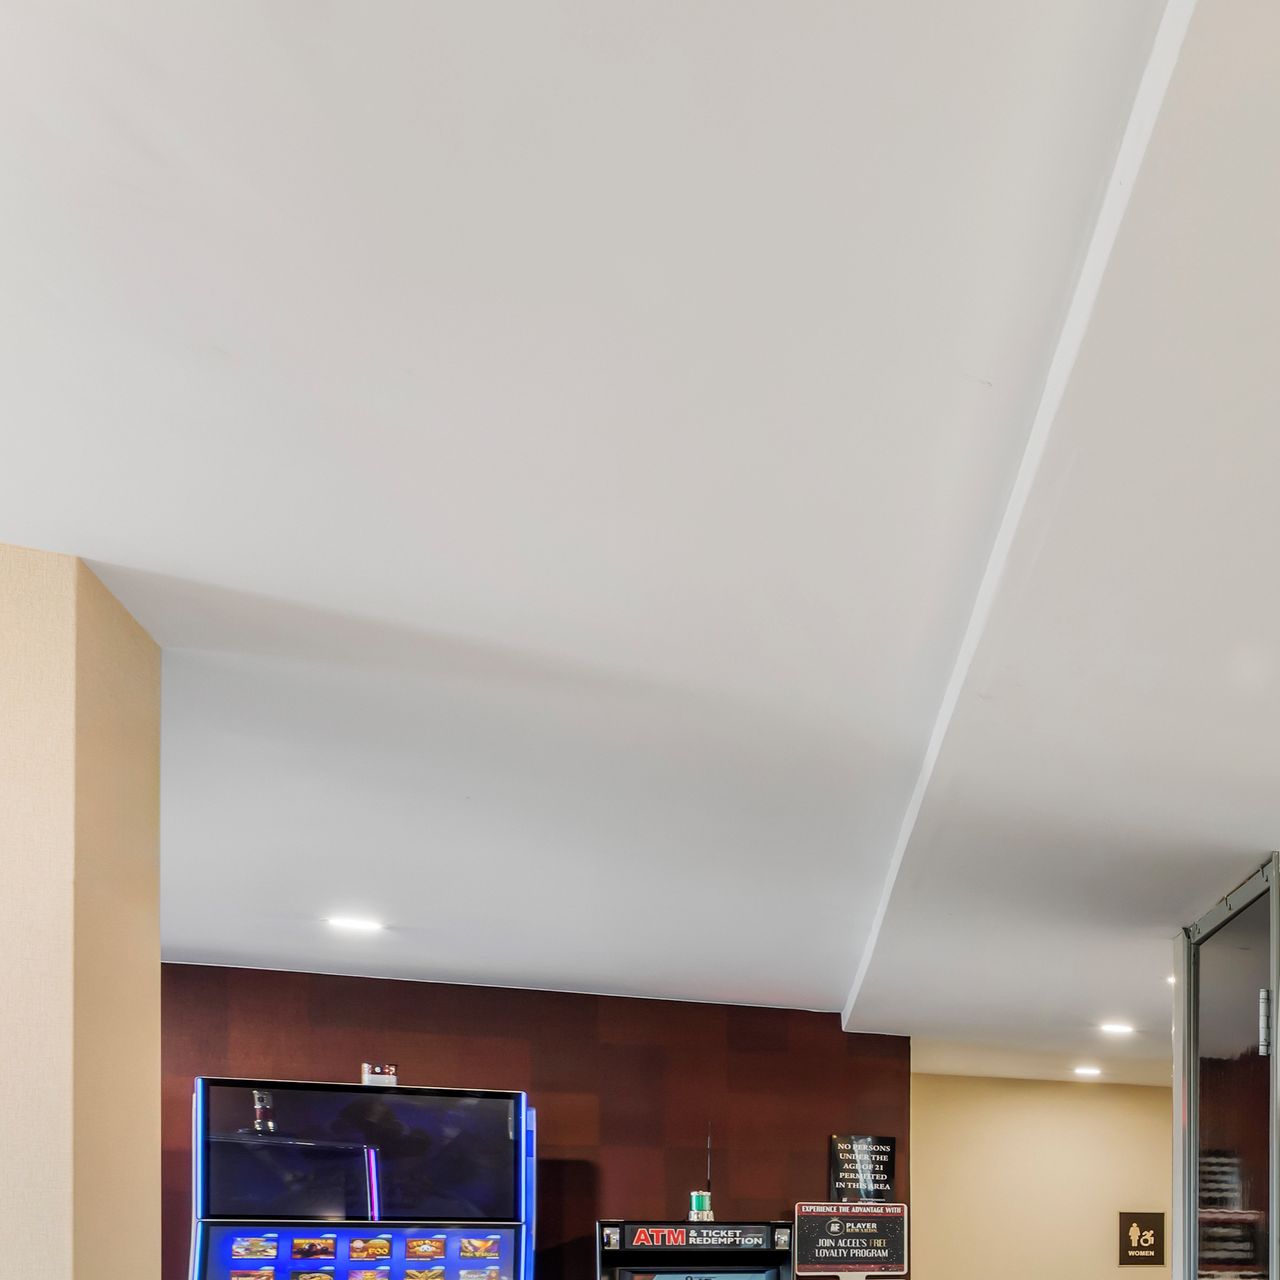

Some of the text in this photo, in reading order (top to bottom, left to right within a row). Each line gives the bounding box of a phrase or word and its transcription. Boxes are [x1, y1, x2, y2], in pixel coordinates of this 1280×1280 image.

[852, 1143, 891, 1152] PERSONS
[839, 1172, 888, 1180] PERMITTED
[801, 1205, 837, 1213] EXPERIENCE
[839, 1205, 849, 1213] THE
[851, 1206, 884, 1214] ADVANTAGE
[633, 1228, 686, 1246] ATM
[701, 1229, 742, 1237] TICKET
[689, 1237, 763, 1245] REDEMPTION
[816, 1239, 887, 1247] JOIN ACCEL'S FREE
[815, 1248, 889, 1257] LOYALTY PROGRAM
